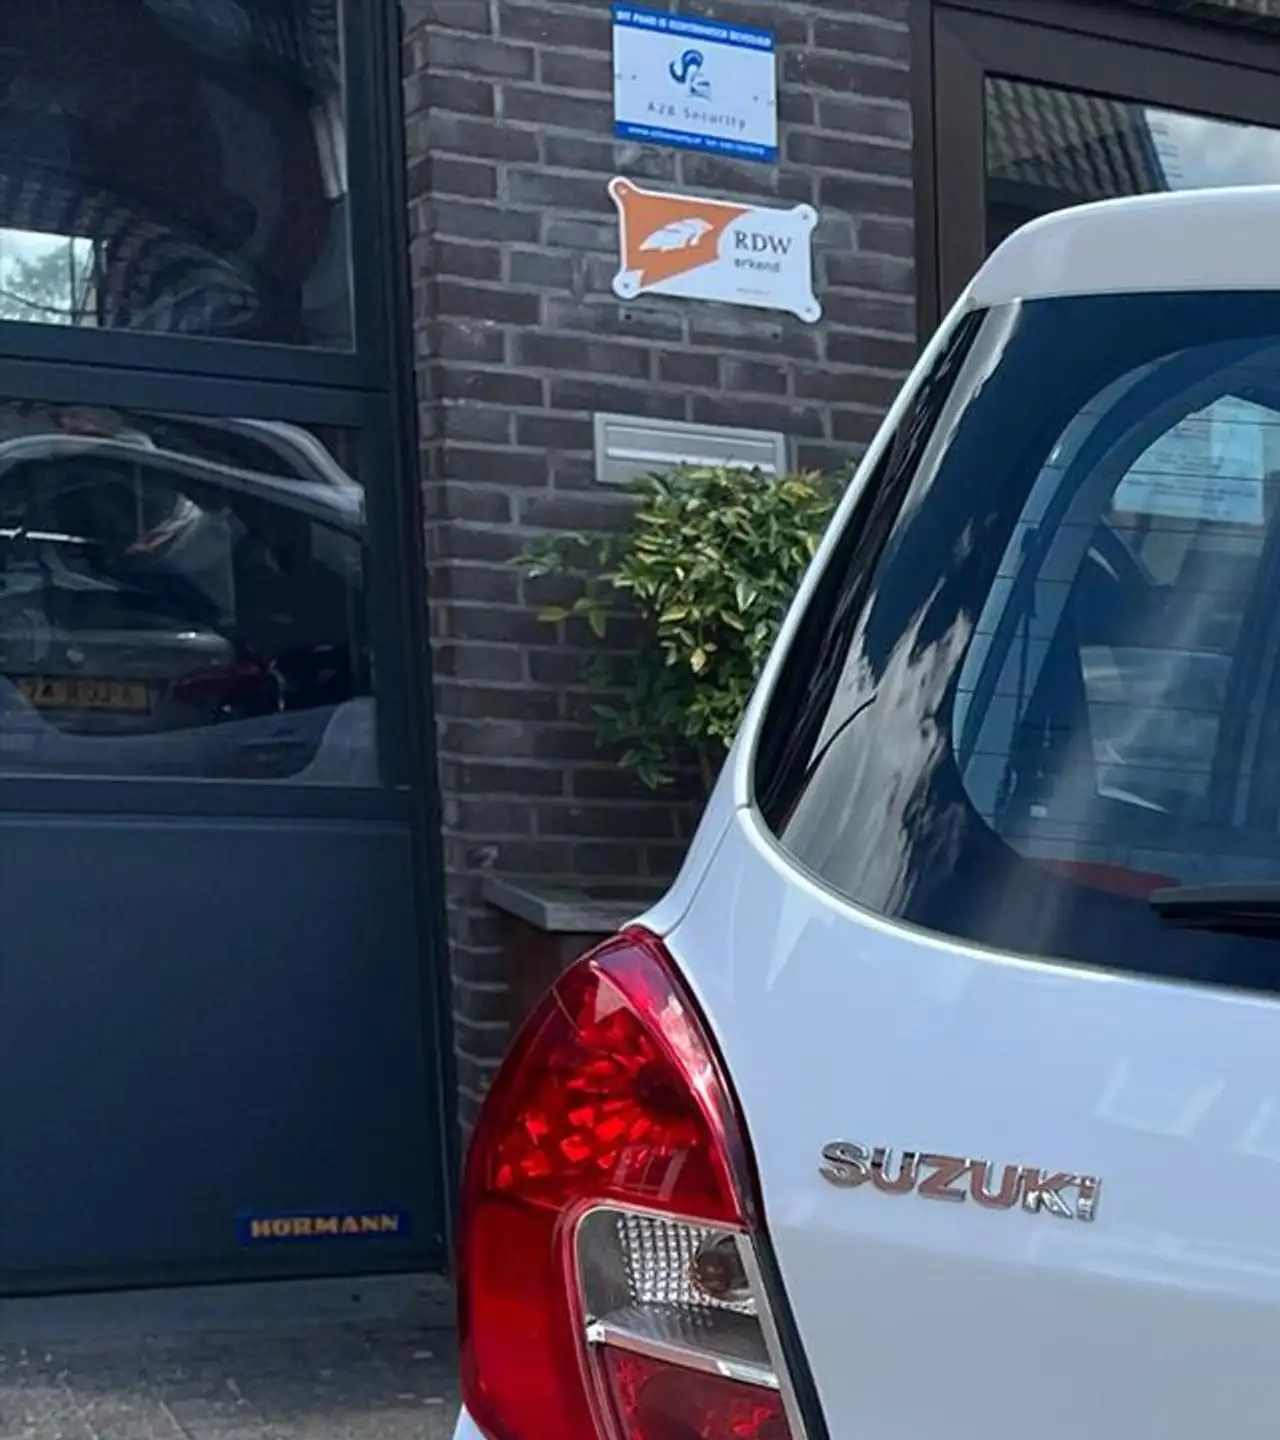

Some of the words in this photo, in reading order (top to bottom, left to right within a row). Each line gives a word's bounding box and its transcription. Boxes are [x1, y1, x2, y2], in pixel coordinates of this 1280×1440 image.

[684, 107, 746, 130] Security
[734, 229, 793, 255] RDW
[734, 258, 781, 273] erkend
[819, 1138, 1102, 1222] SUZUKI
